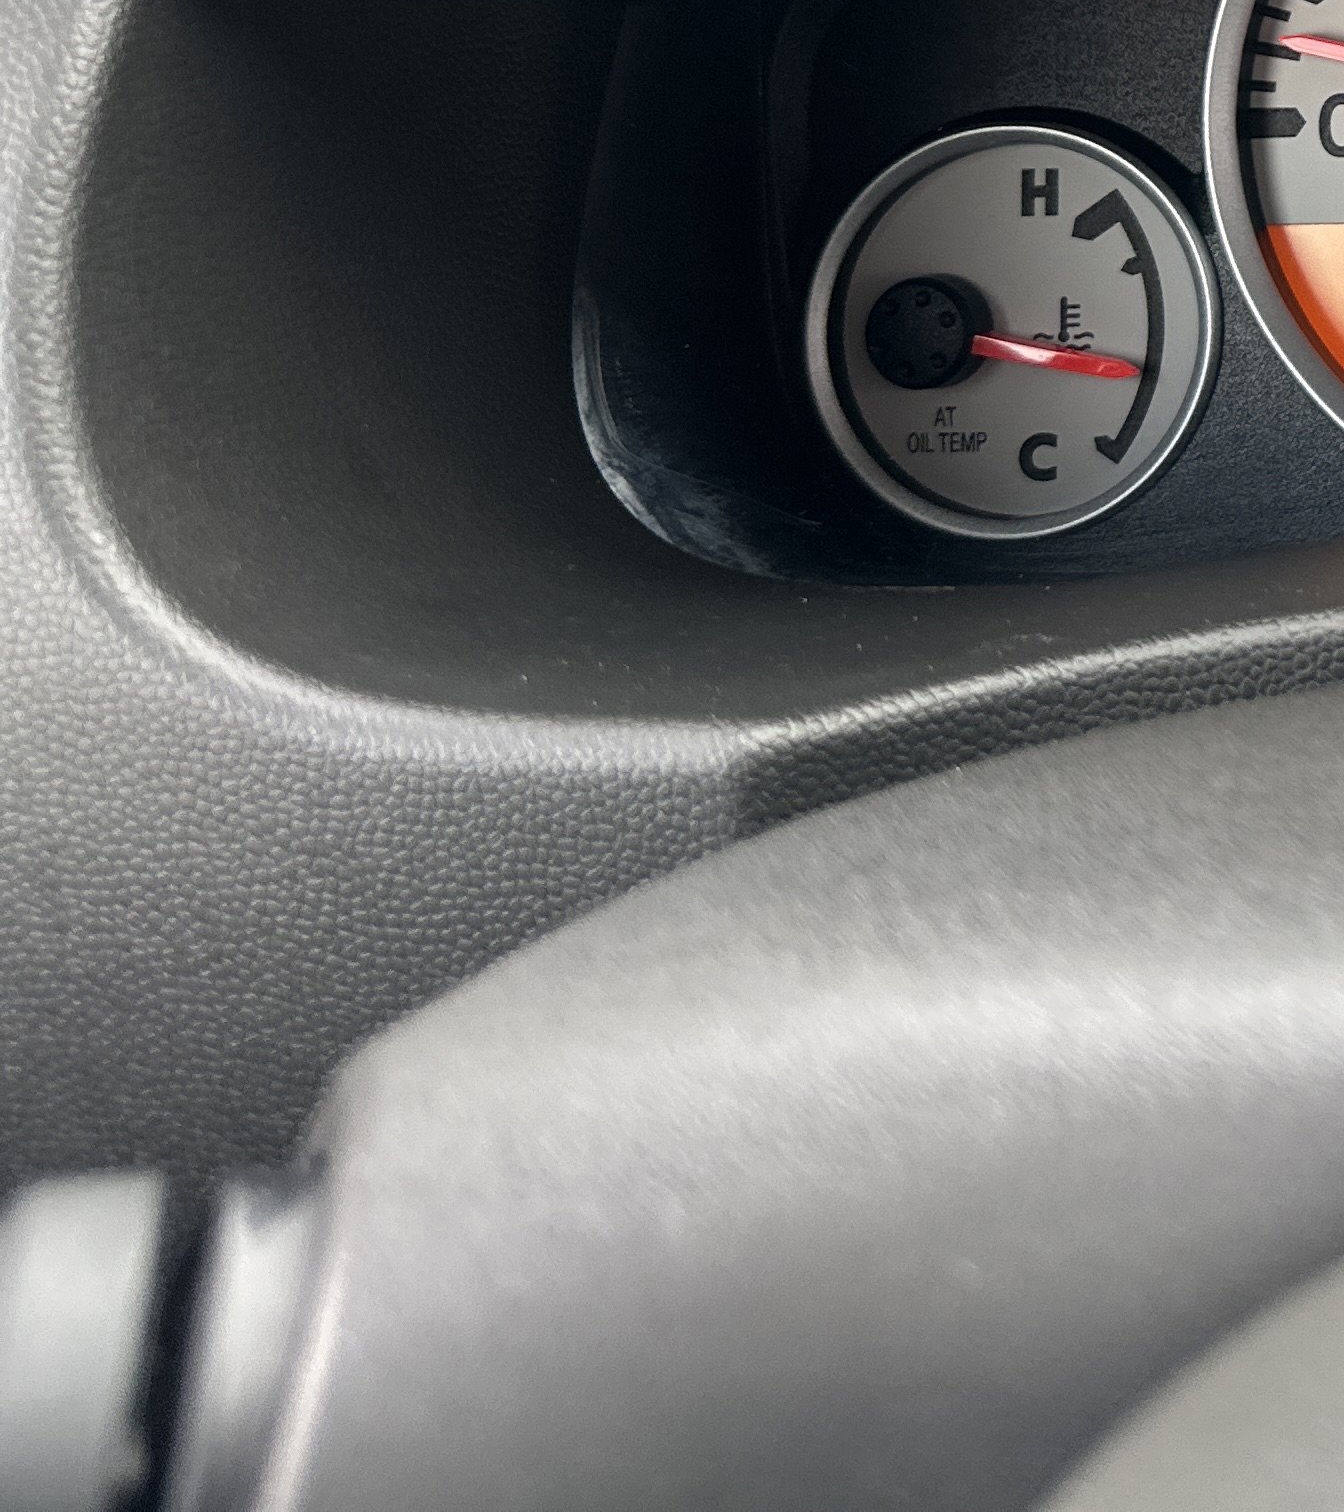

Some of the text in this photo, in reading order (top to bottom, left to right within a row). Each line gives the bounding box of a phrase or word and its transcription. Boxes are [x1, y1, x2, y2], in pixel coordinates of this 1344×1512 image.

[1020, 167, 1059, 217] H
[934, 405, 957, 428] AT
[907, 431, 988, 455] OIL TEMP
[1017, 432, 1058, 483] C
